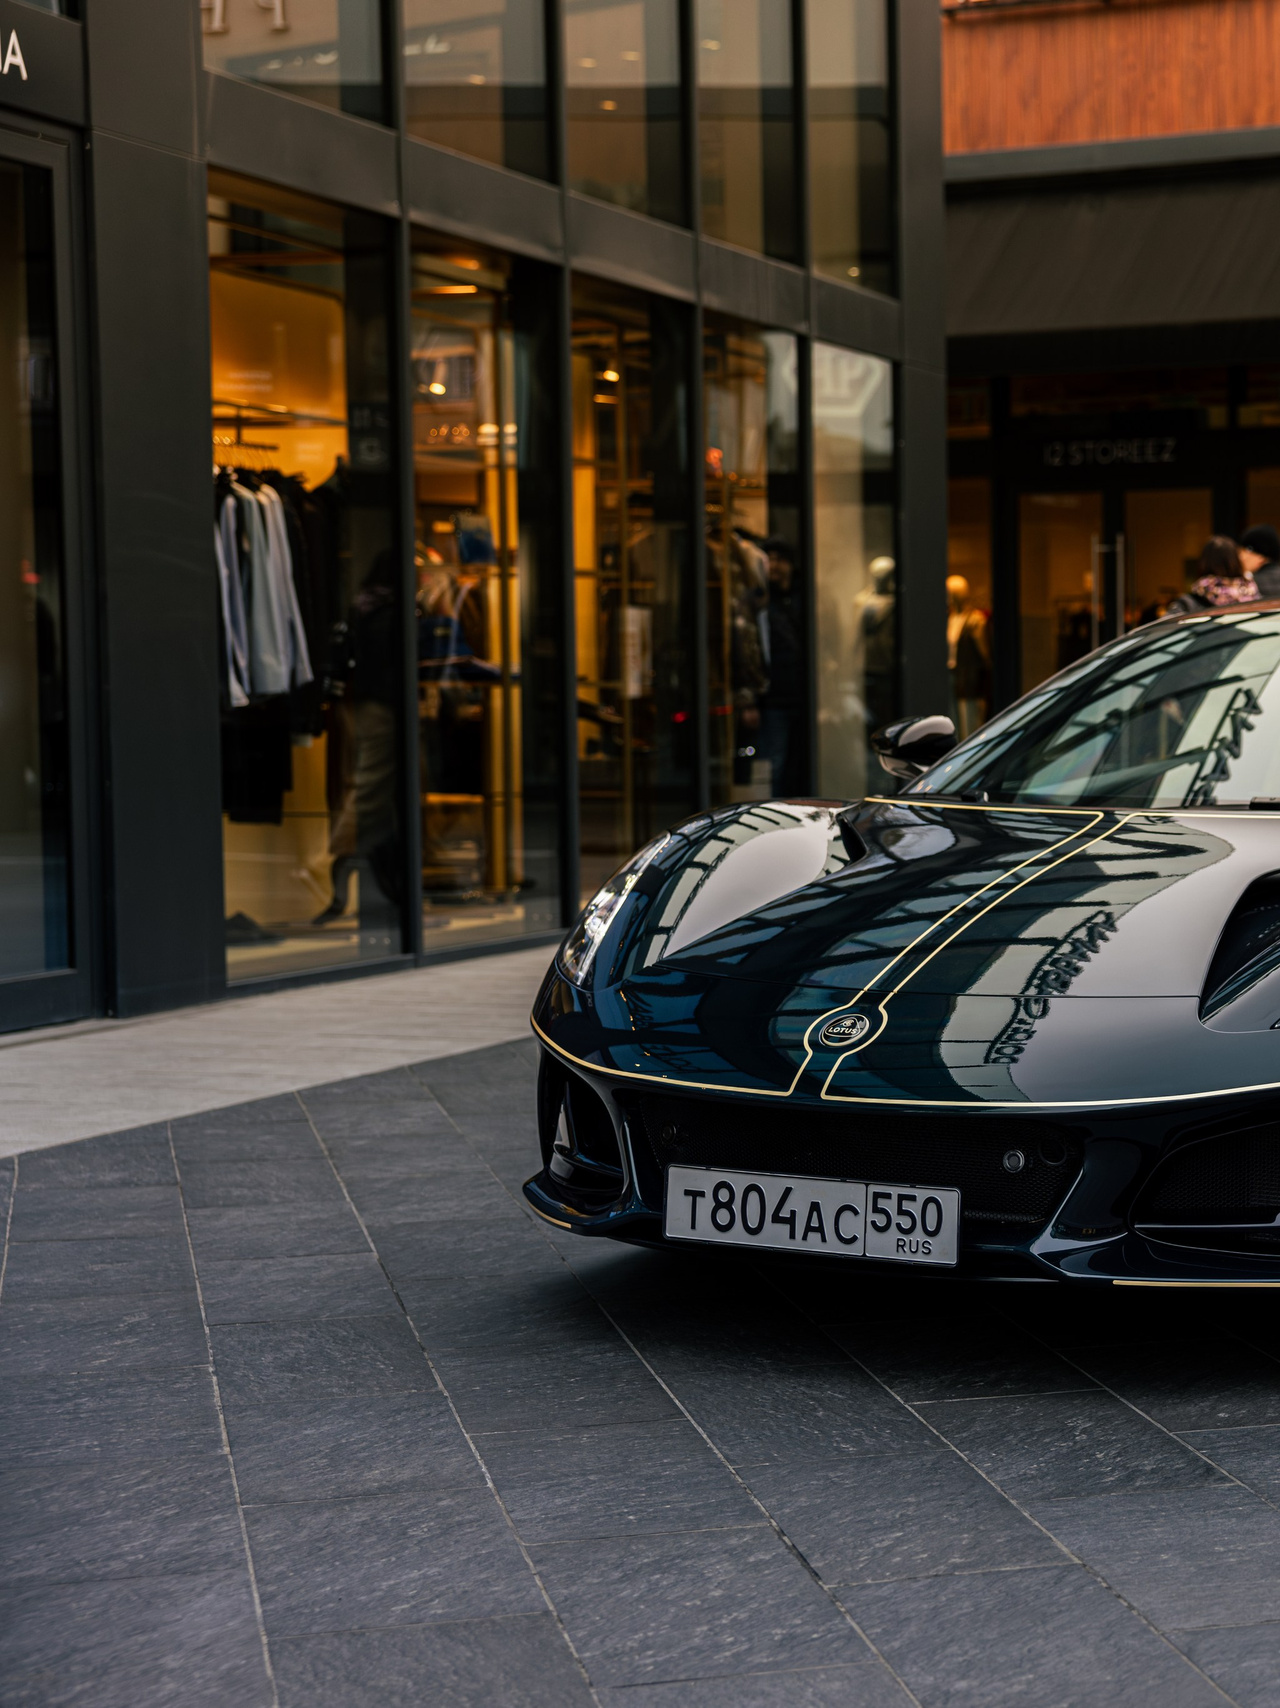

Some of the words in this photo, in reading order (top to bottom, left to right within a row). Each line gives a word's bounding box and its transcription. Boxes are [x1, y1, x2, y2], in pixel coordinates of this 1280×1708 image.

[1067, 436, 1177, 465] STOREEZ
[828, 1026, 858, 1034] LOTUS
[684, 1180, 860, 1245] T804AC
[870, 1191, 943, 1237] 550
[896, 1237, 932, 1255] RUS
